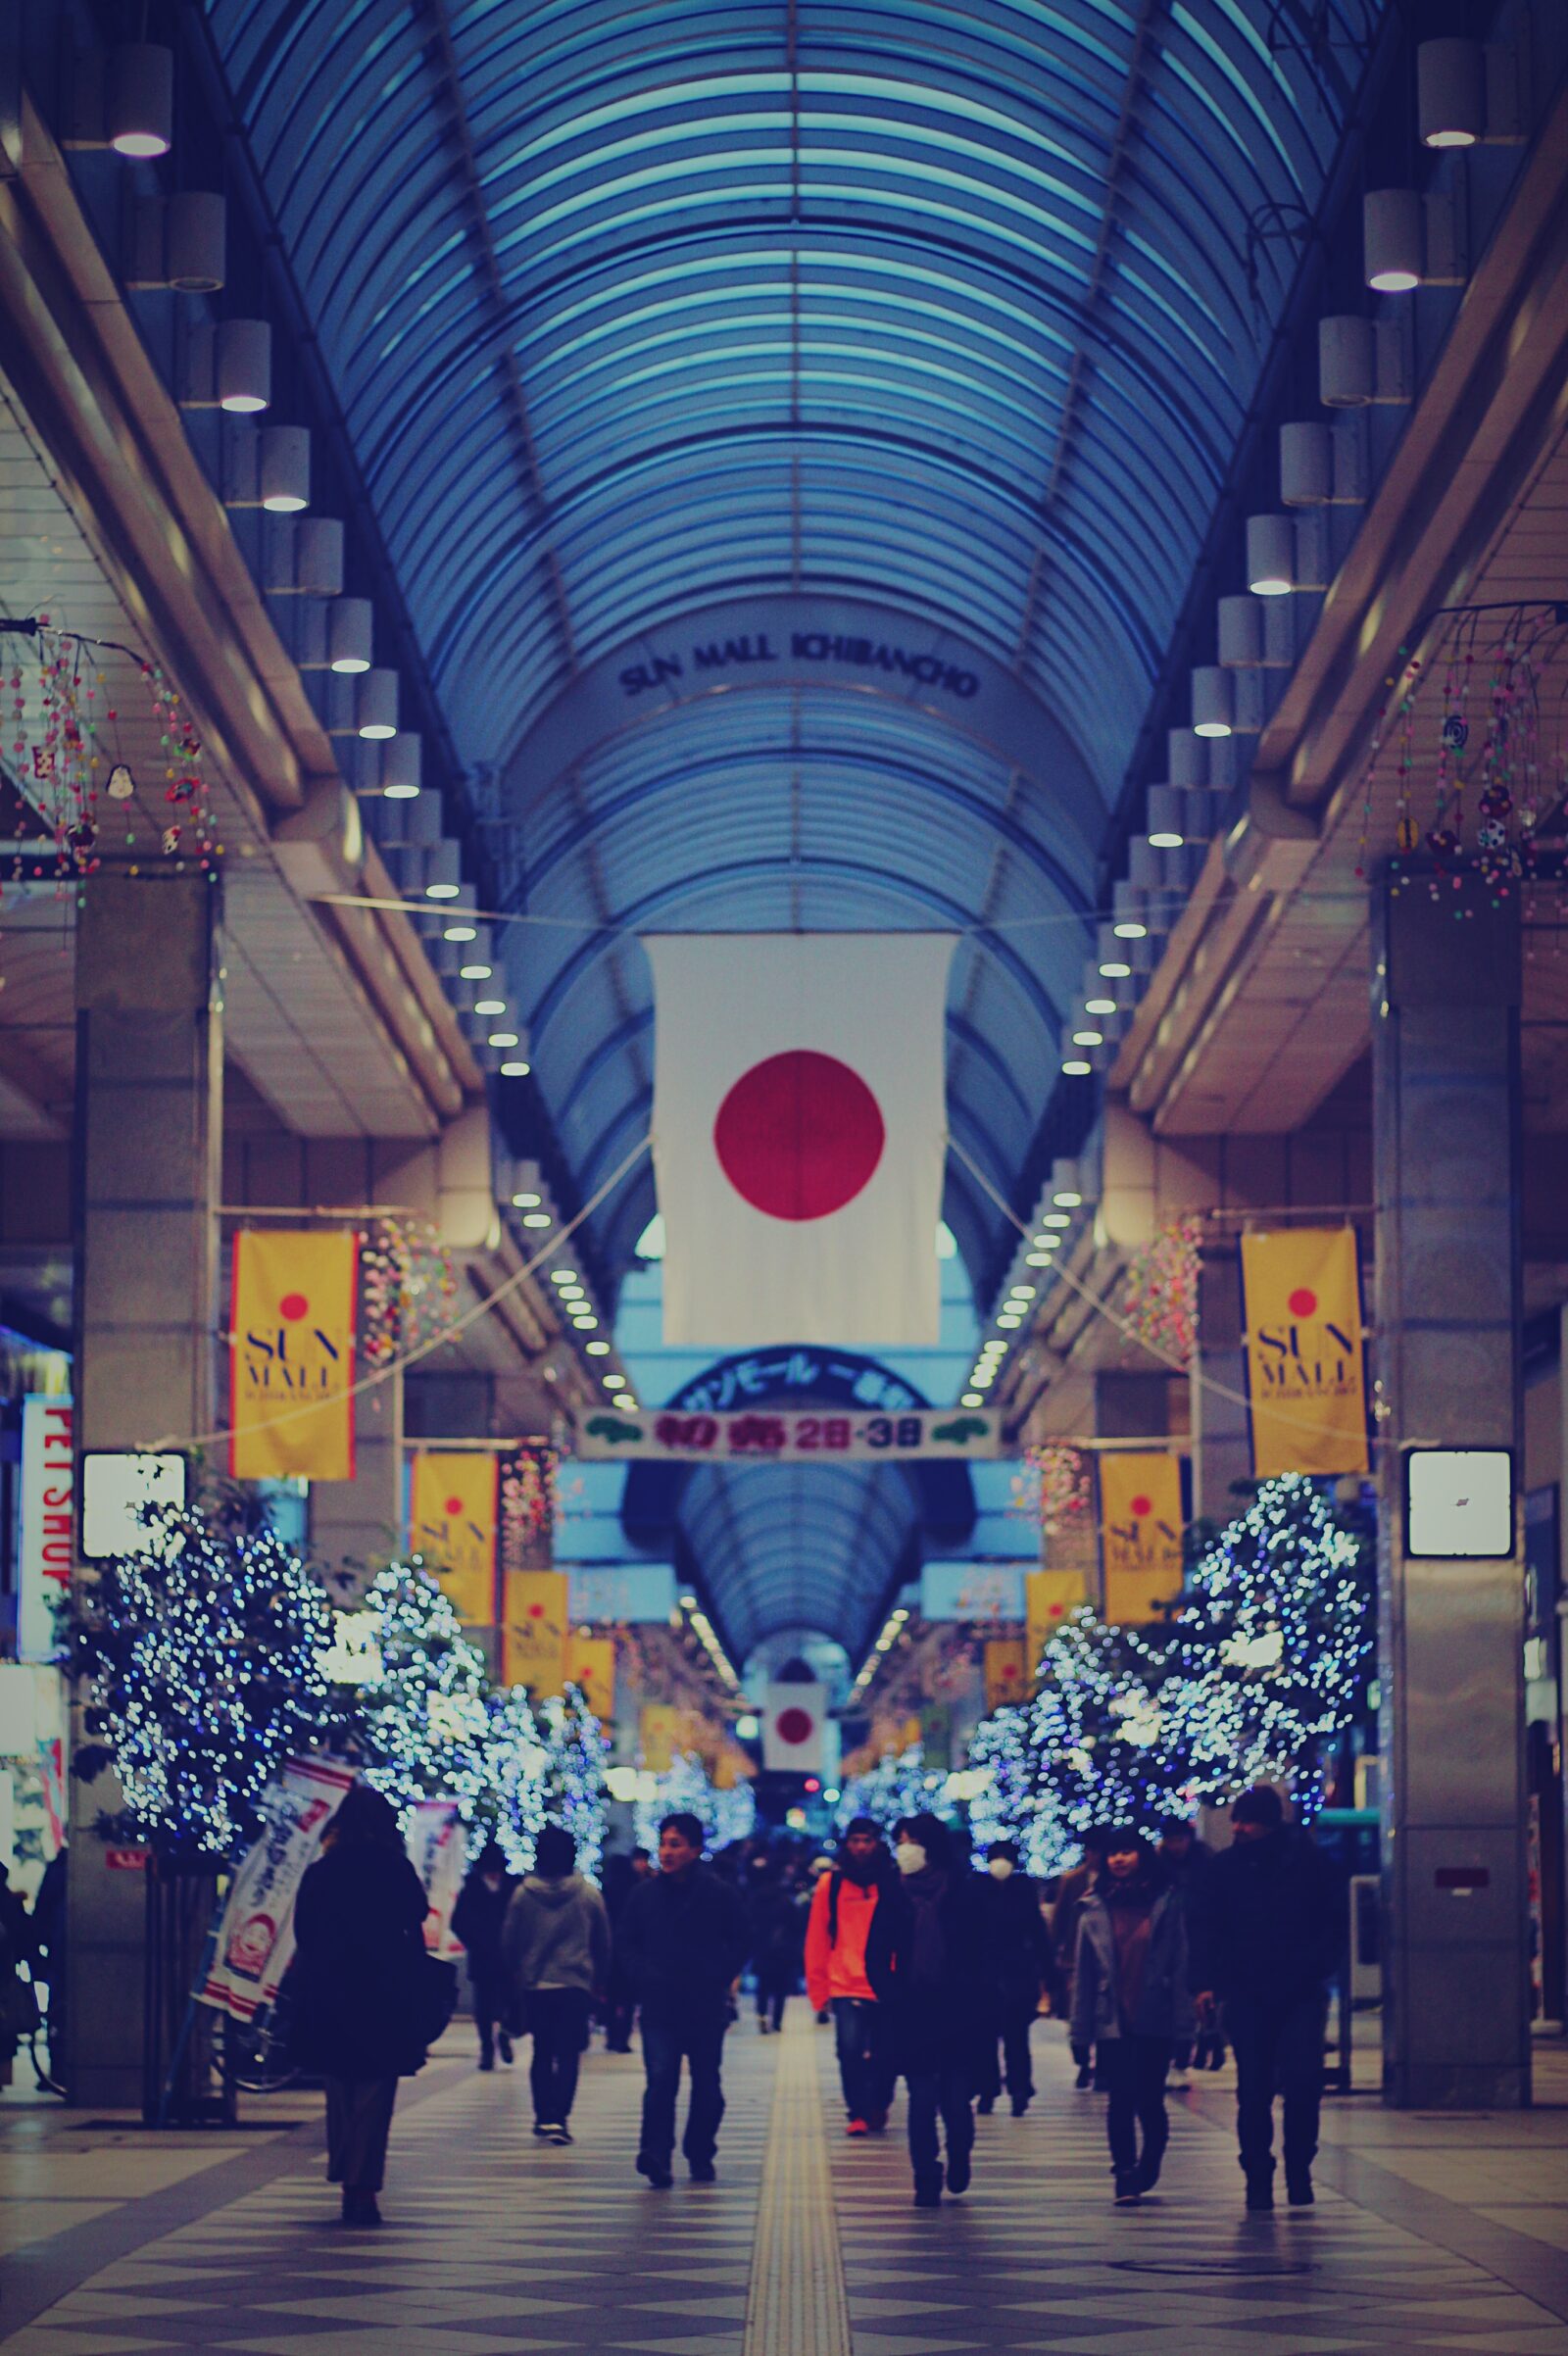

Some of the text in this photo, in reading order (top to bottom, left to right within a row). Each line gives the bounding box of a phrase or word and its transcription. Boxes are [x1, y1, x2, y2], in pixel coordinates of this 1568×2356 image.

[618, 632, 980, 699] SUN MALL ICHIBANCHO
[245, 1327, 340, 1362] SUN
[1257, 1323, 1353, 1359] SUN
